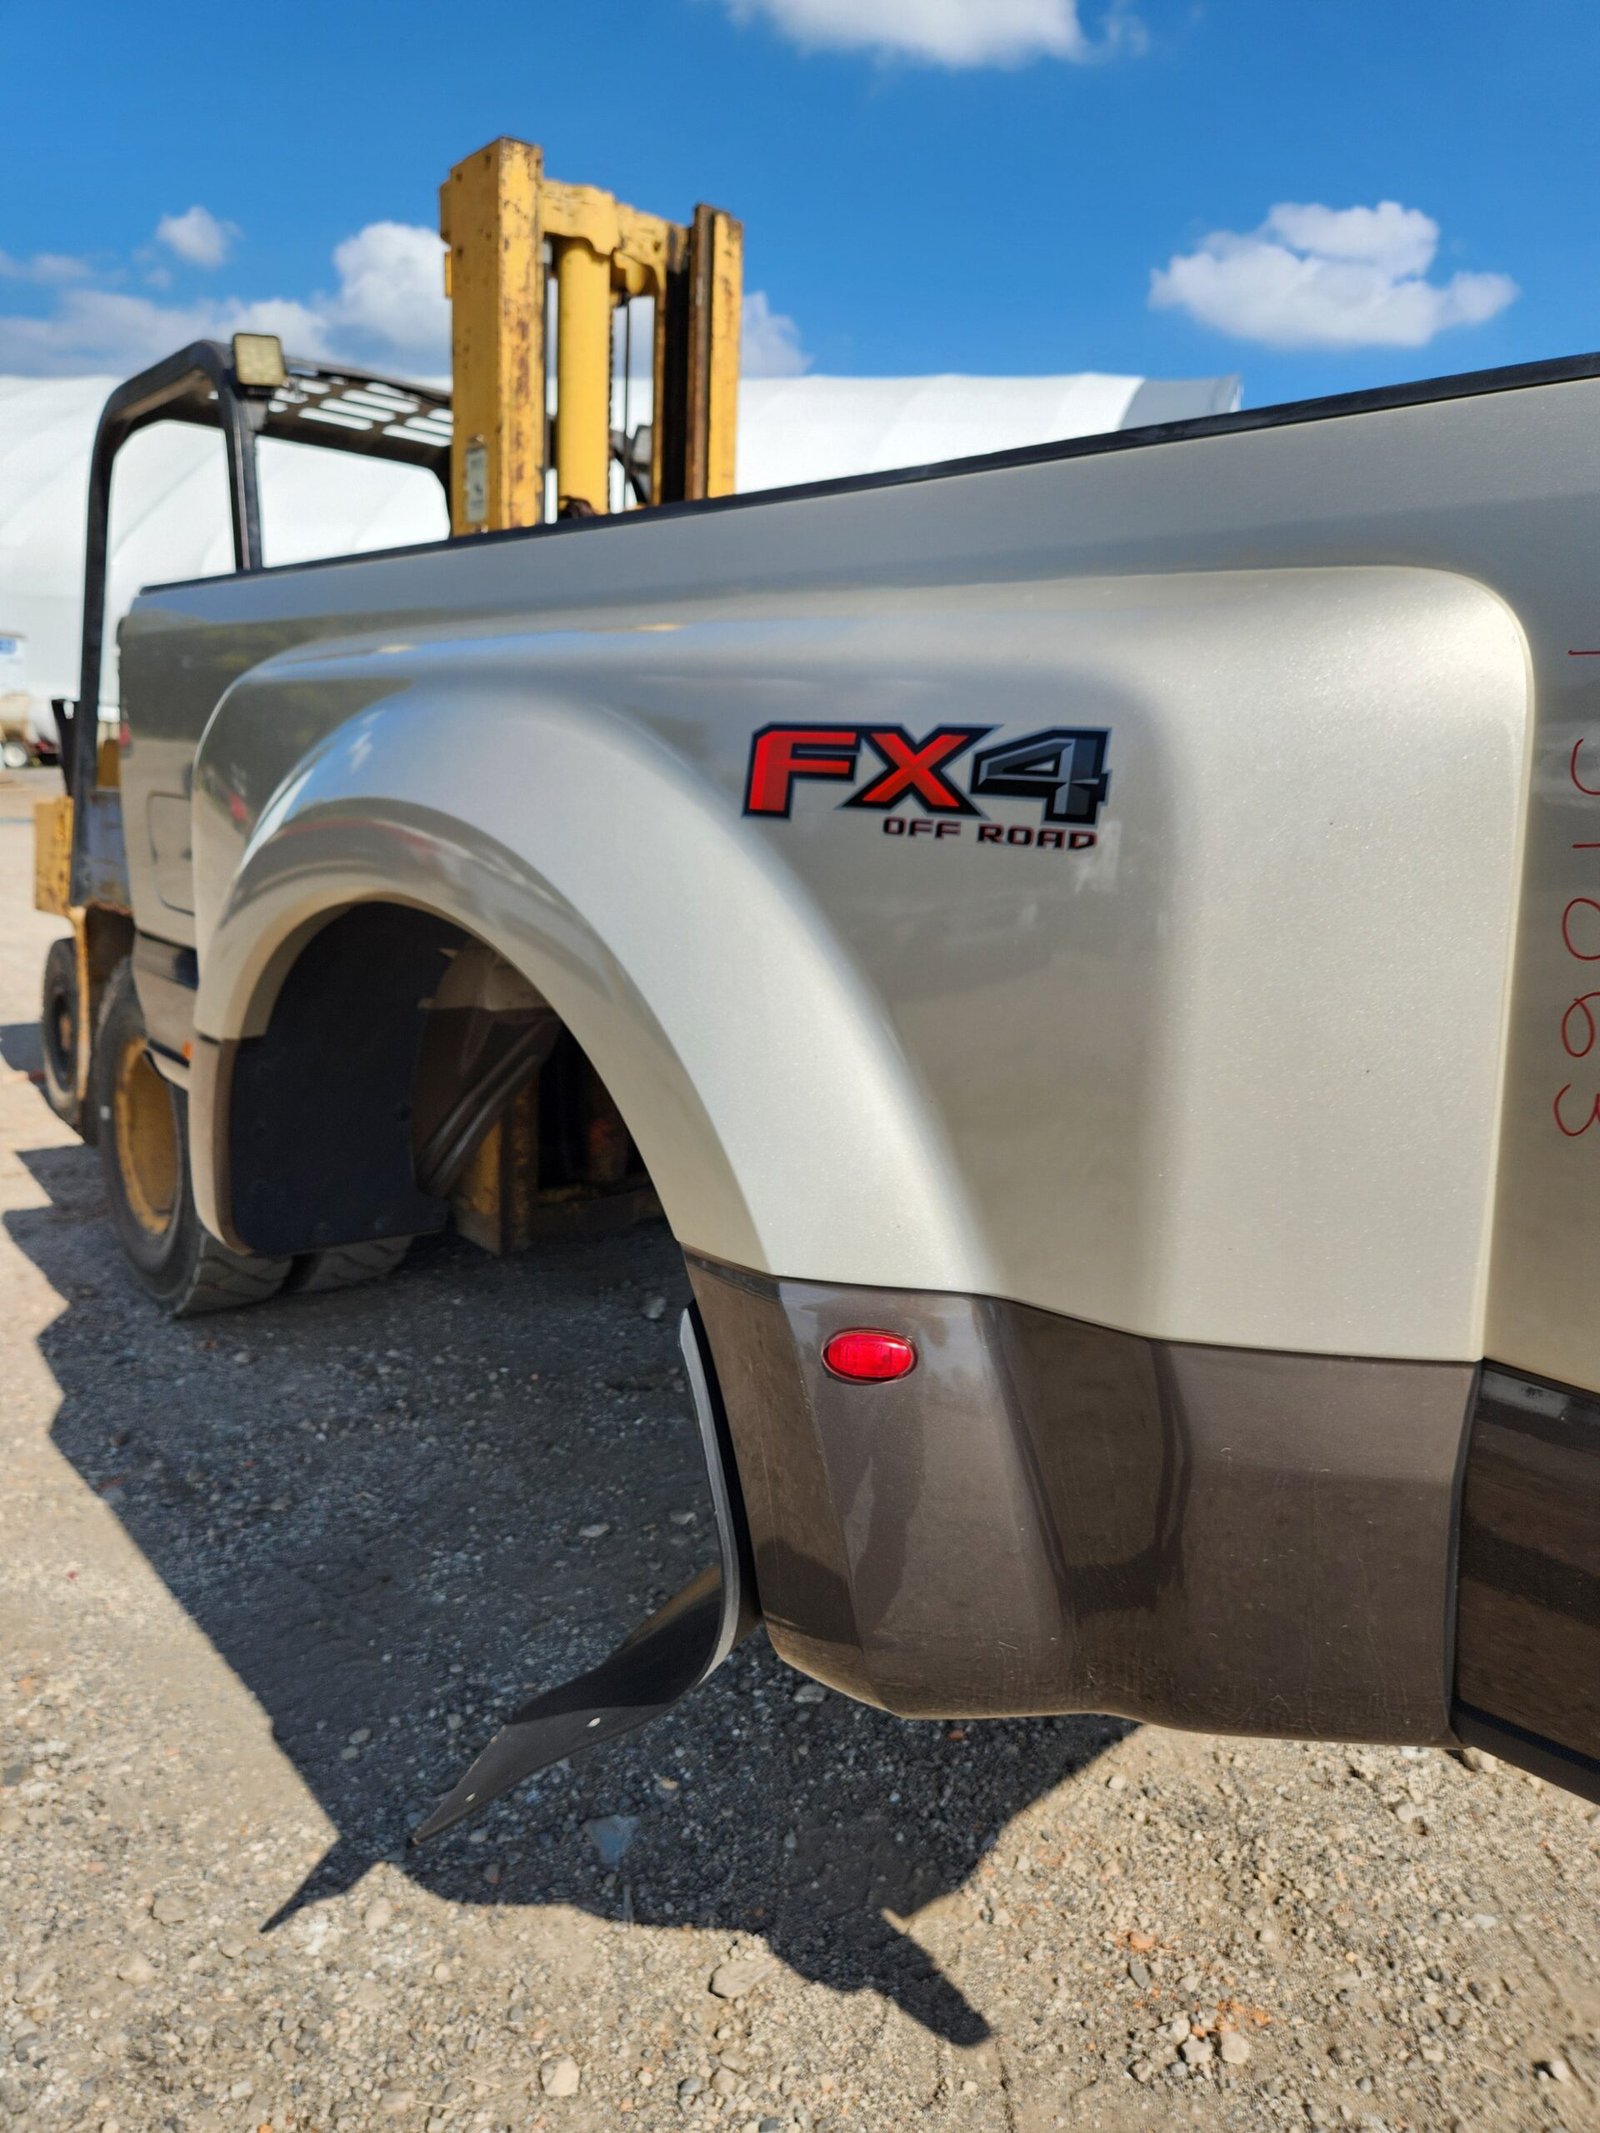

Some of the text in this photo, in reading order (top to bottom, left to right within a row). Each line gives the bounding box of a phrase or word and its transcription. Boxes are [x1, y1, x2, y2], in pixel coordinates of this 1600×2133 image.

[742, 722, 1111, 825] FX4
[882, 817, 1098, 849] OFF ROAD
